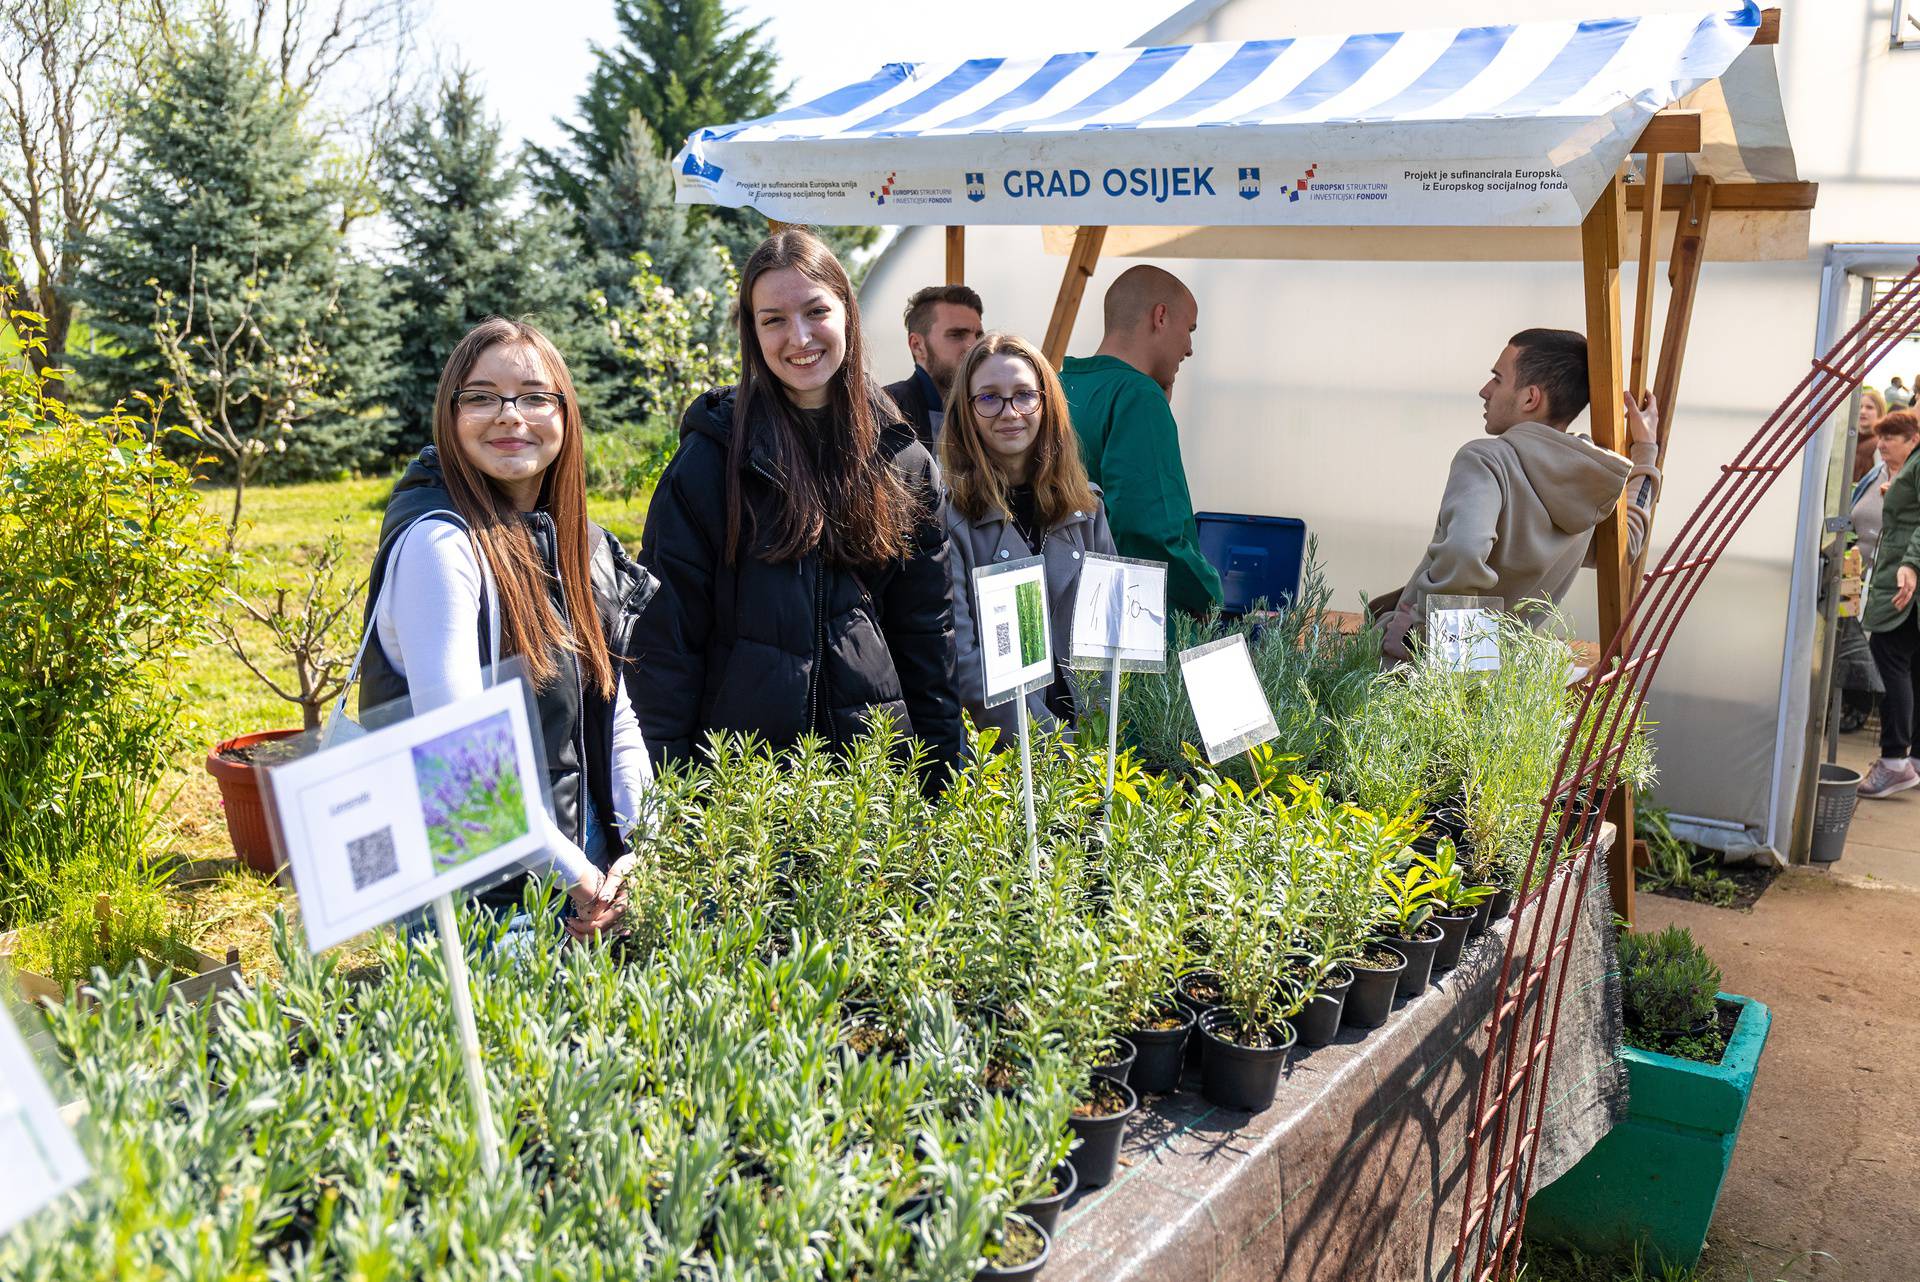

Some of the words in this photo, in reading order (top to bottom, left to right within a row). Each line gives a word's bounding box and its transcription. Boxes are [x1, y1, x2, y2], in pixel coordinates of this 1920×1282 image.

[1404, 170, 1437, 181] Projekt
[1439, 170, 1448, 181] je
[1450, 169, 1513, 179] sufinancirala
[736, 181, 760, 190] Projekt
[761, 182, 768, 190] je
[769, 181, 808, 189] sufinancirala
[809, 181, 840, 189] Europska
[841, 180, 858, 189] unija
[1003, 169, 1091, 198] GRAD
[1102, 167, 1216, 203] OSIJEK
[1310, 183, 1345, 191] EUROPSKI
[1346, 183, 1388, 191] STRUKTURNI
[1422, 182, 1431, 191] iz
[1432, 181, 1485, 193] Europskog
[1486, 181, 1537, 192] socijalnog
[1540, 180, 1568, 190] fonda
[756, 190, 792, 199] Europskog
[793, 190, 826, 199] socijalnog
[1313, 193, 1355, 202] INVESTICIJSKI
